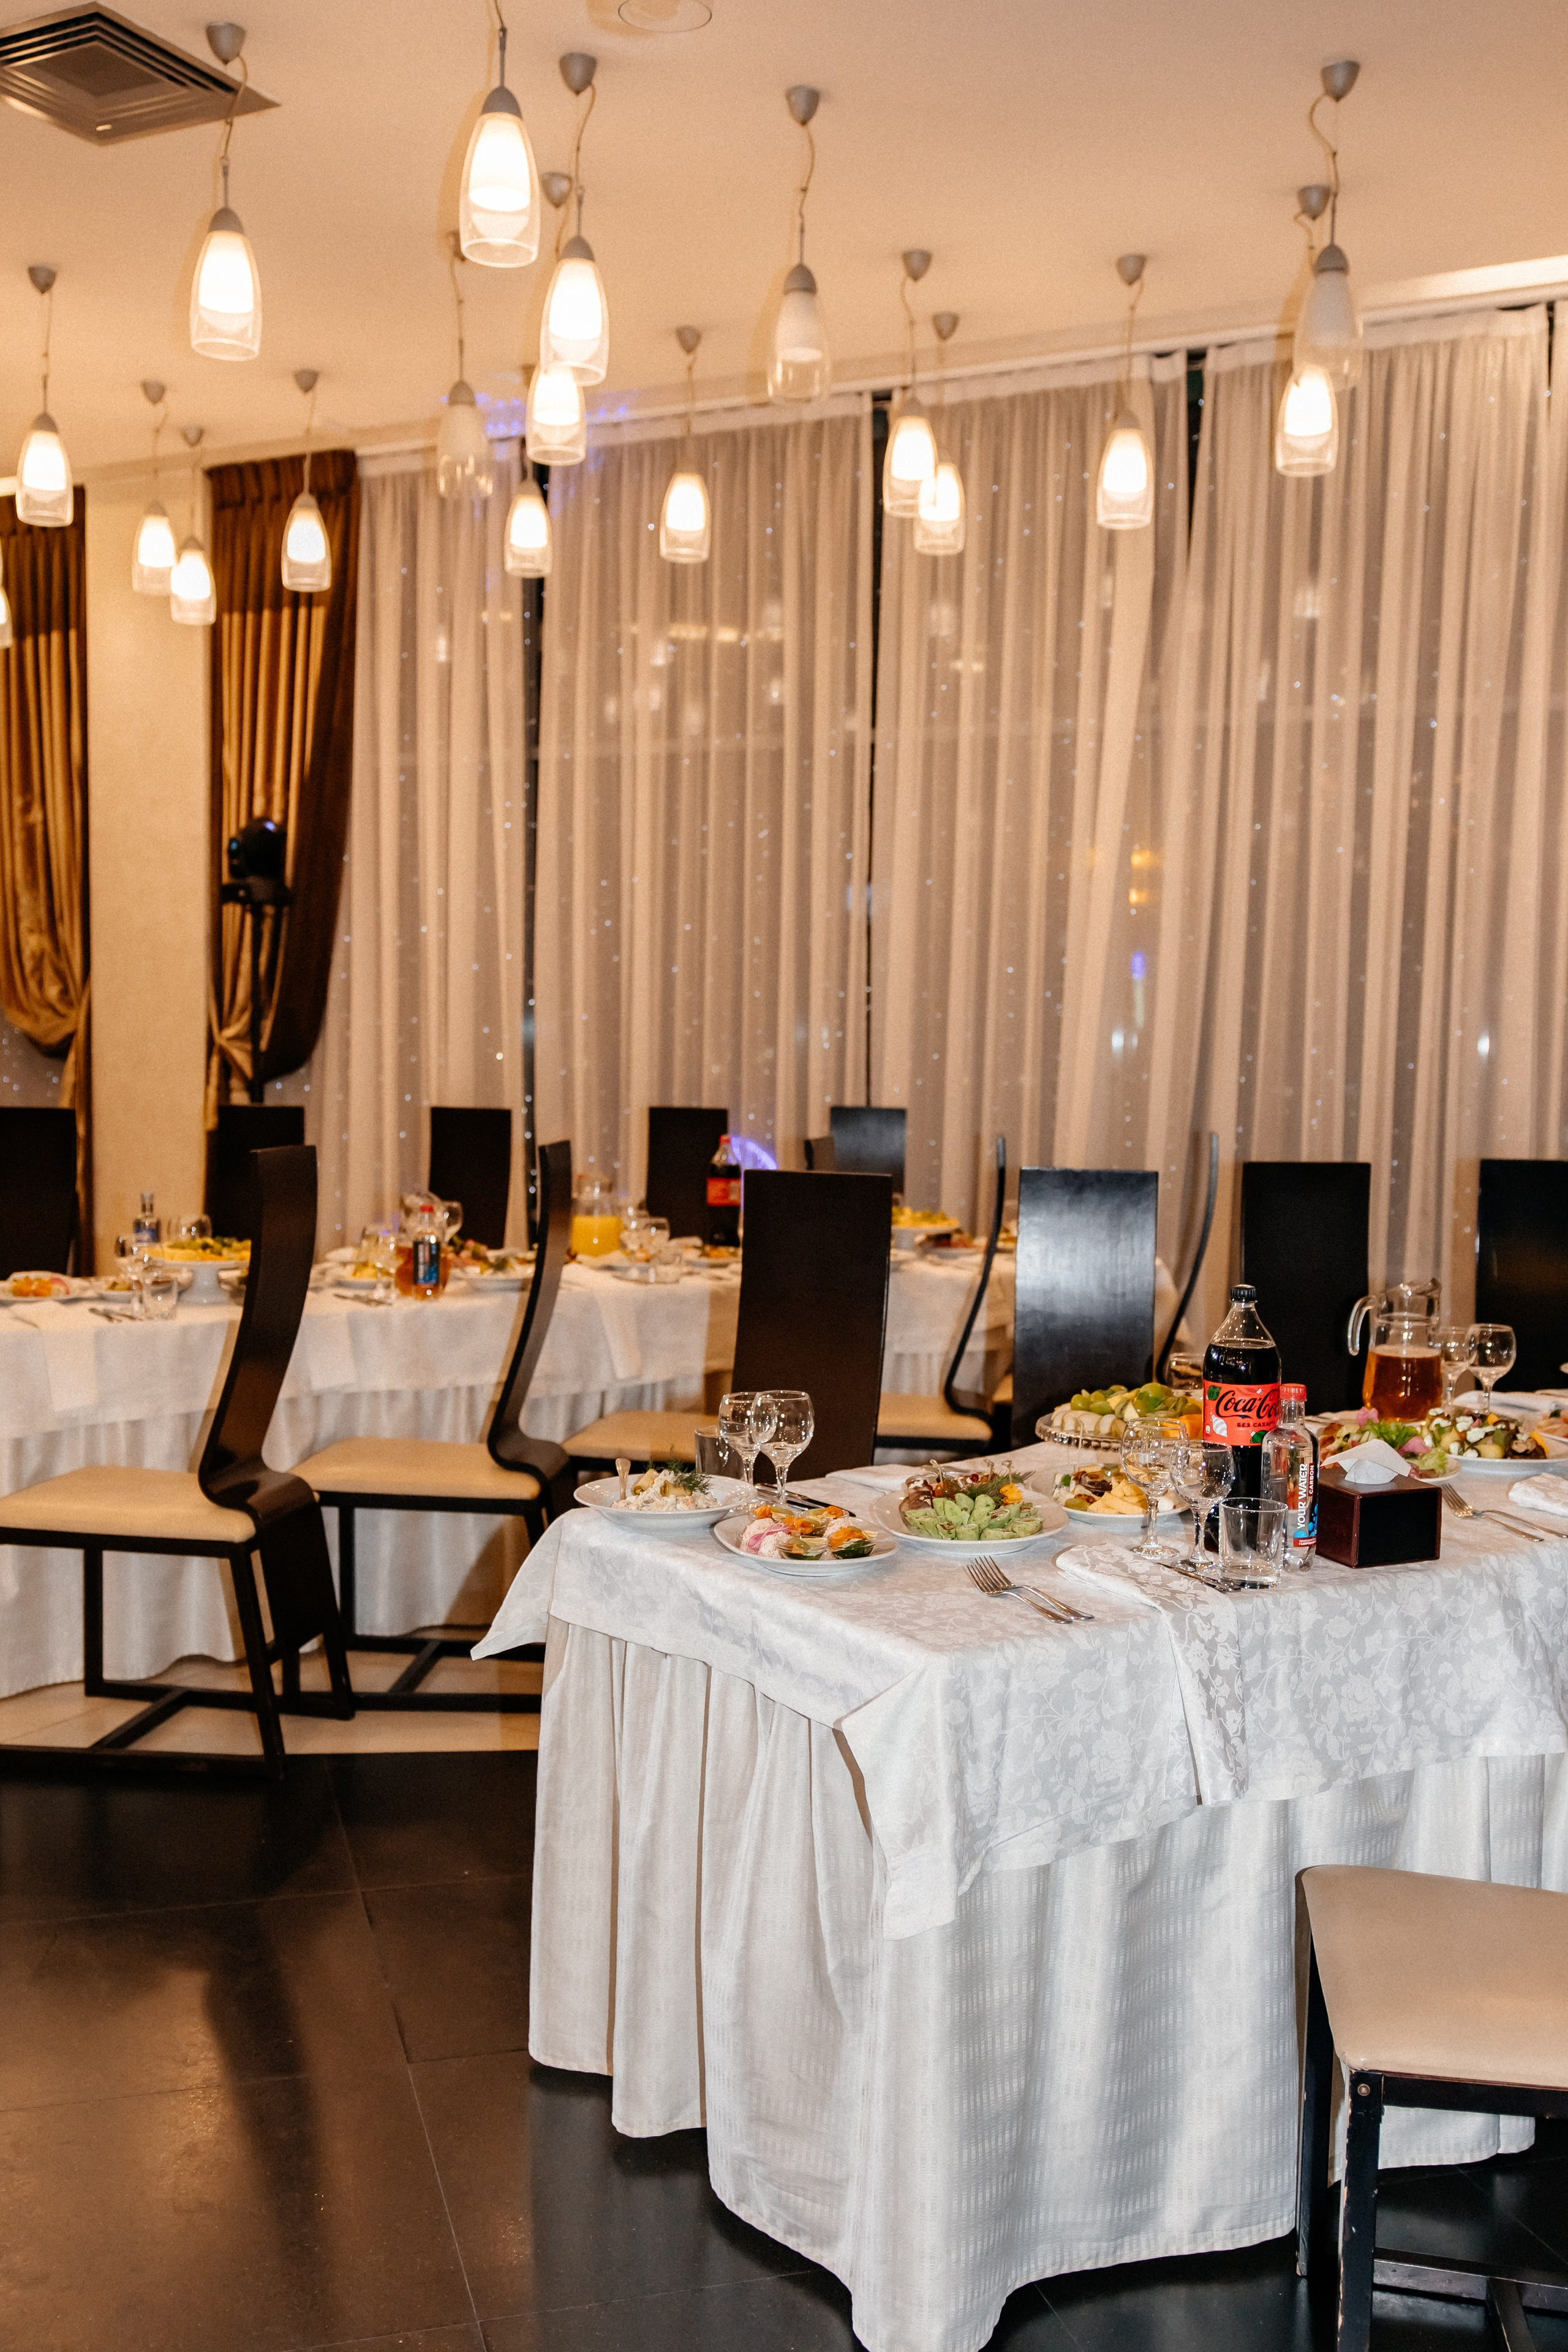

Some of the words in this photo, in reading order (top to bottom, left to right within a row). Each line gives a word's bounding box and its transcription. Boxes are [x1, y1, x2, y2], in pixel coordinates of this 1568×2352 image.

[1216, 1389, 1278, 1419] Coca-Co
[1298, 1463, 1308, 1501] WATER
[1297, 1501, 1306, 1529] YOUR
